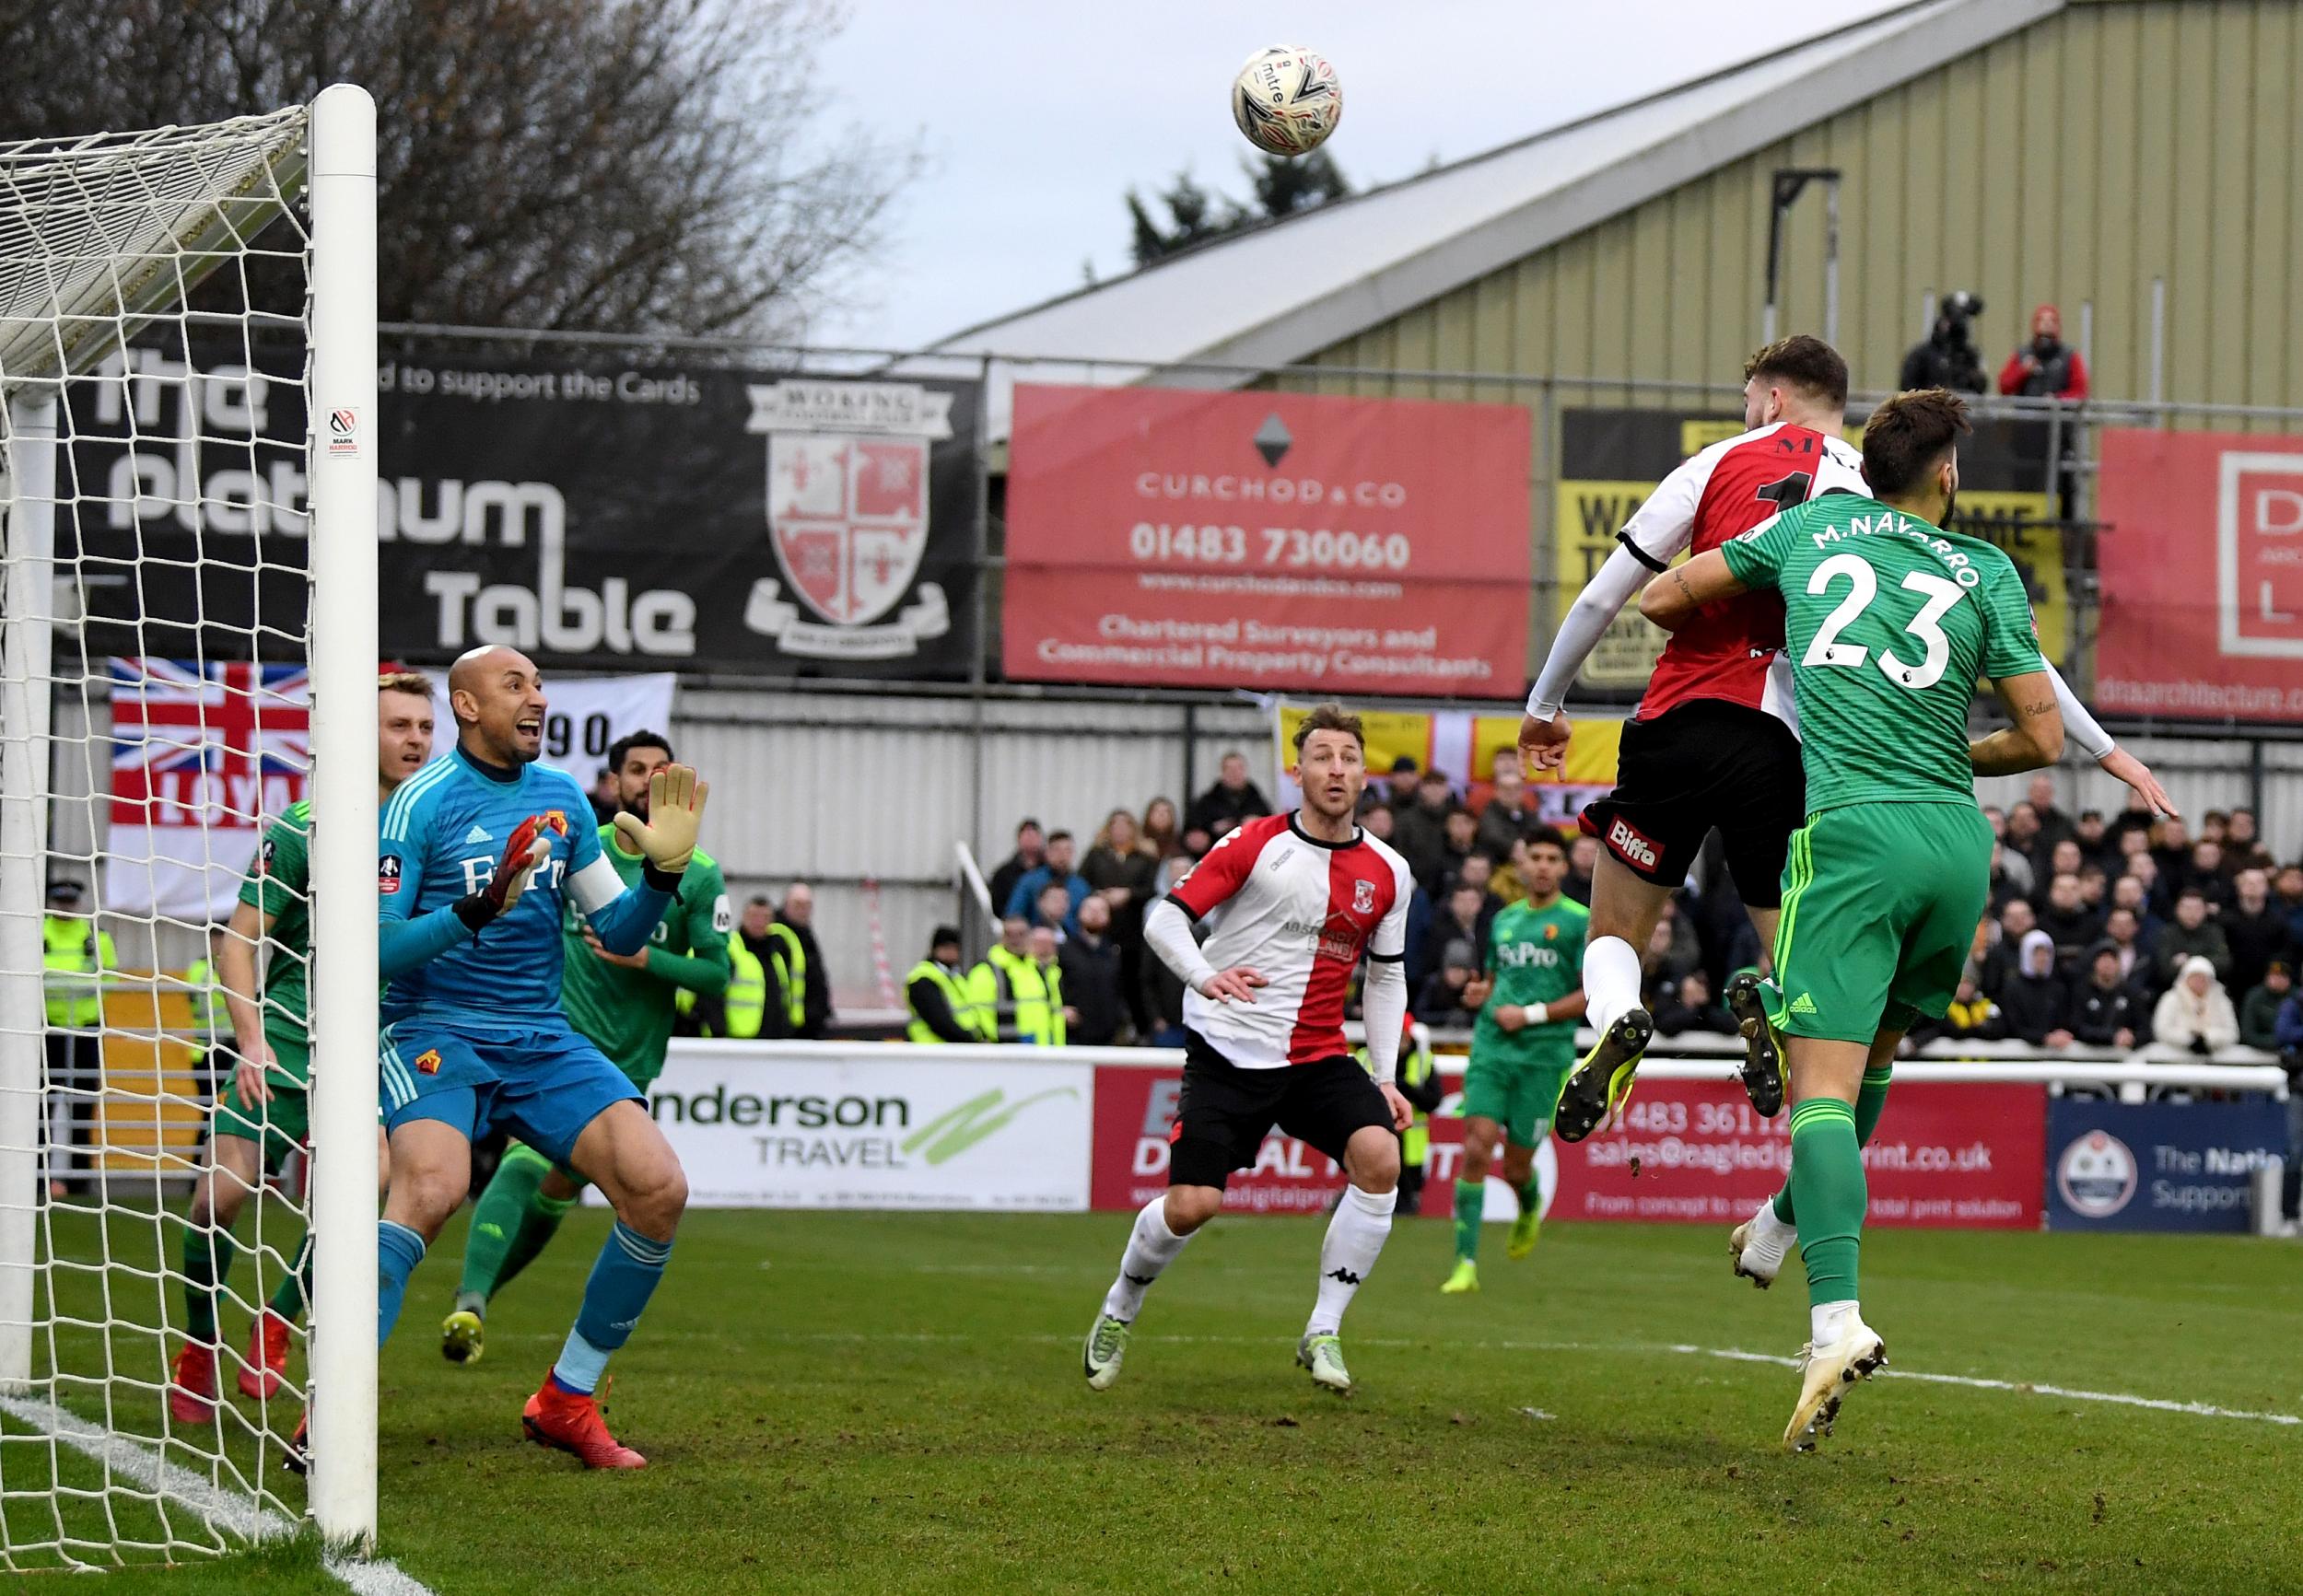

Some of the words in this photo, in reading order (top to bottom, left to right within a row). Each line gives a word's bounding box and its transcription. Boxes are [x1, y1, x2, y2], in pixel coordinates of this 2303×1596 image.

[1262, 62, 1284, 103] mitre
[95, 347, 270, 433] The
[400, 366, 435, 394] to
[438, 369, 556, 402] support
[561, 368, 614, 402] the
[615, 371, 702, 405] Cards
[108, 451, 567, 548] Platum
[1137, 472, 1324, 506] CURCHOD
[1353, 481, 1407, 507] CO
[1129, 521, 1247, 564] 01483
[1261, 526, 1411, 569] 730060
[425, 570, 697, 656] Table
[1098, 613, 1239, 643] Chartered
[1245, 619, 1379, 651] Surveyors
[1384, 624, 1438, 650] and
[1800, 553, 1968, 689] 23
[1037, 637, 1203, 669] Commercial
[1208, 645, 1328, 678] Property
[1332, 648, 1492, 680] Consultants
[158, 772, 310, 825] LOYA
[1609, 820, 1656, 866] Biffa
[650, 1086, 909, 1129] nderson
[753, 1136, 910, 1171] TRAVEL
[2152, 1144, 2203, 1176] The
